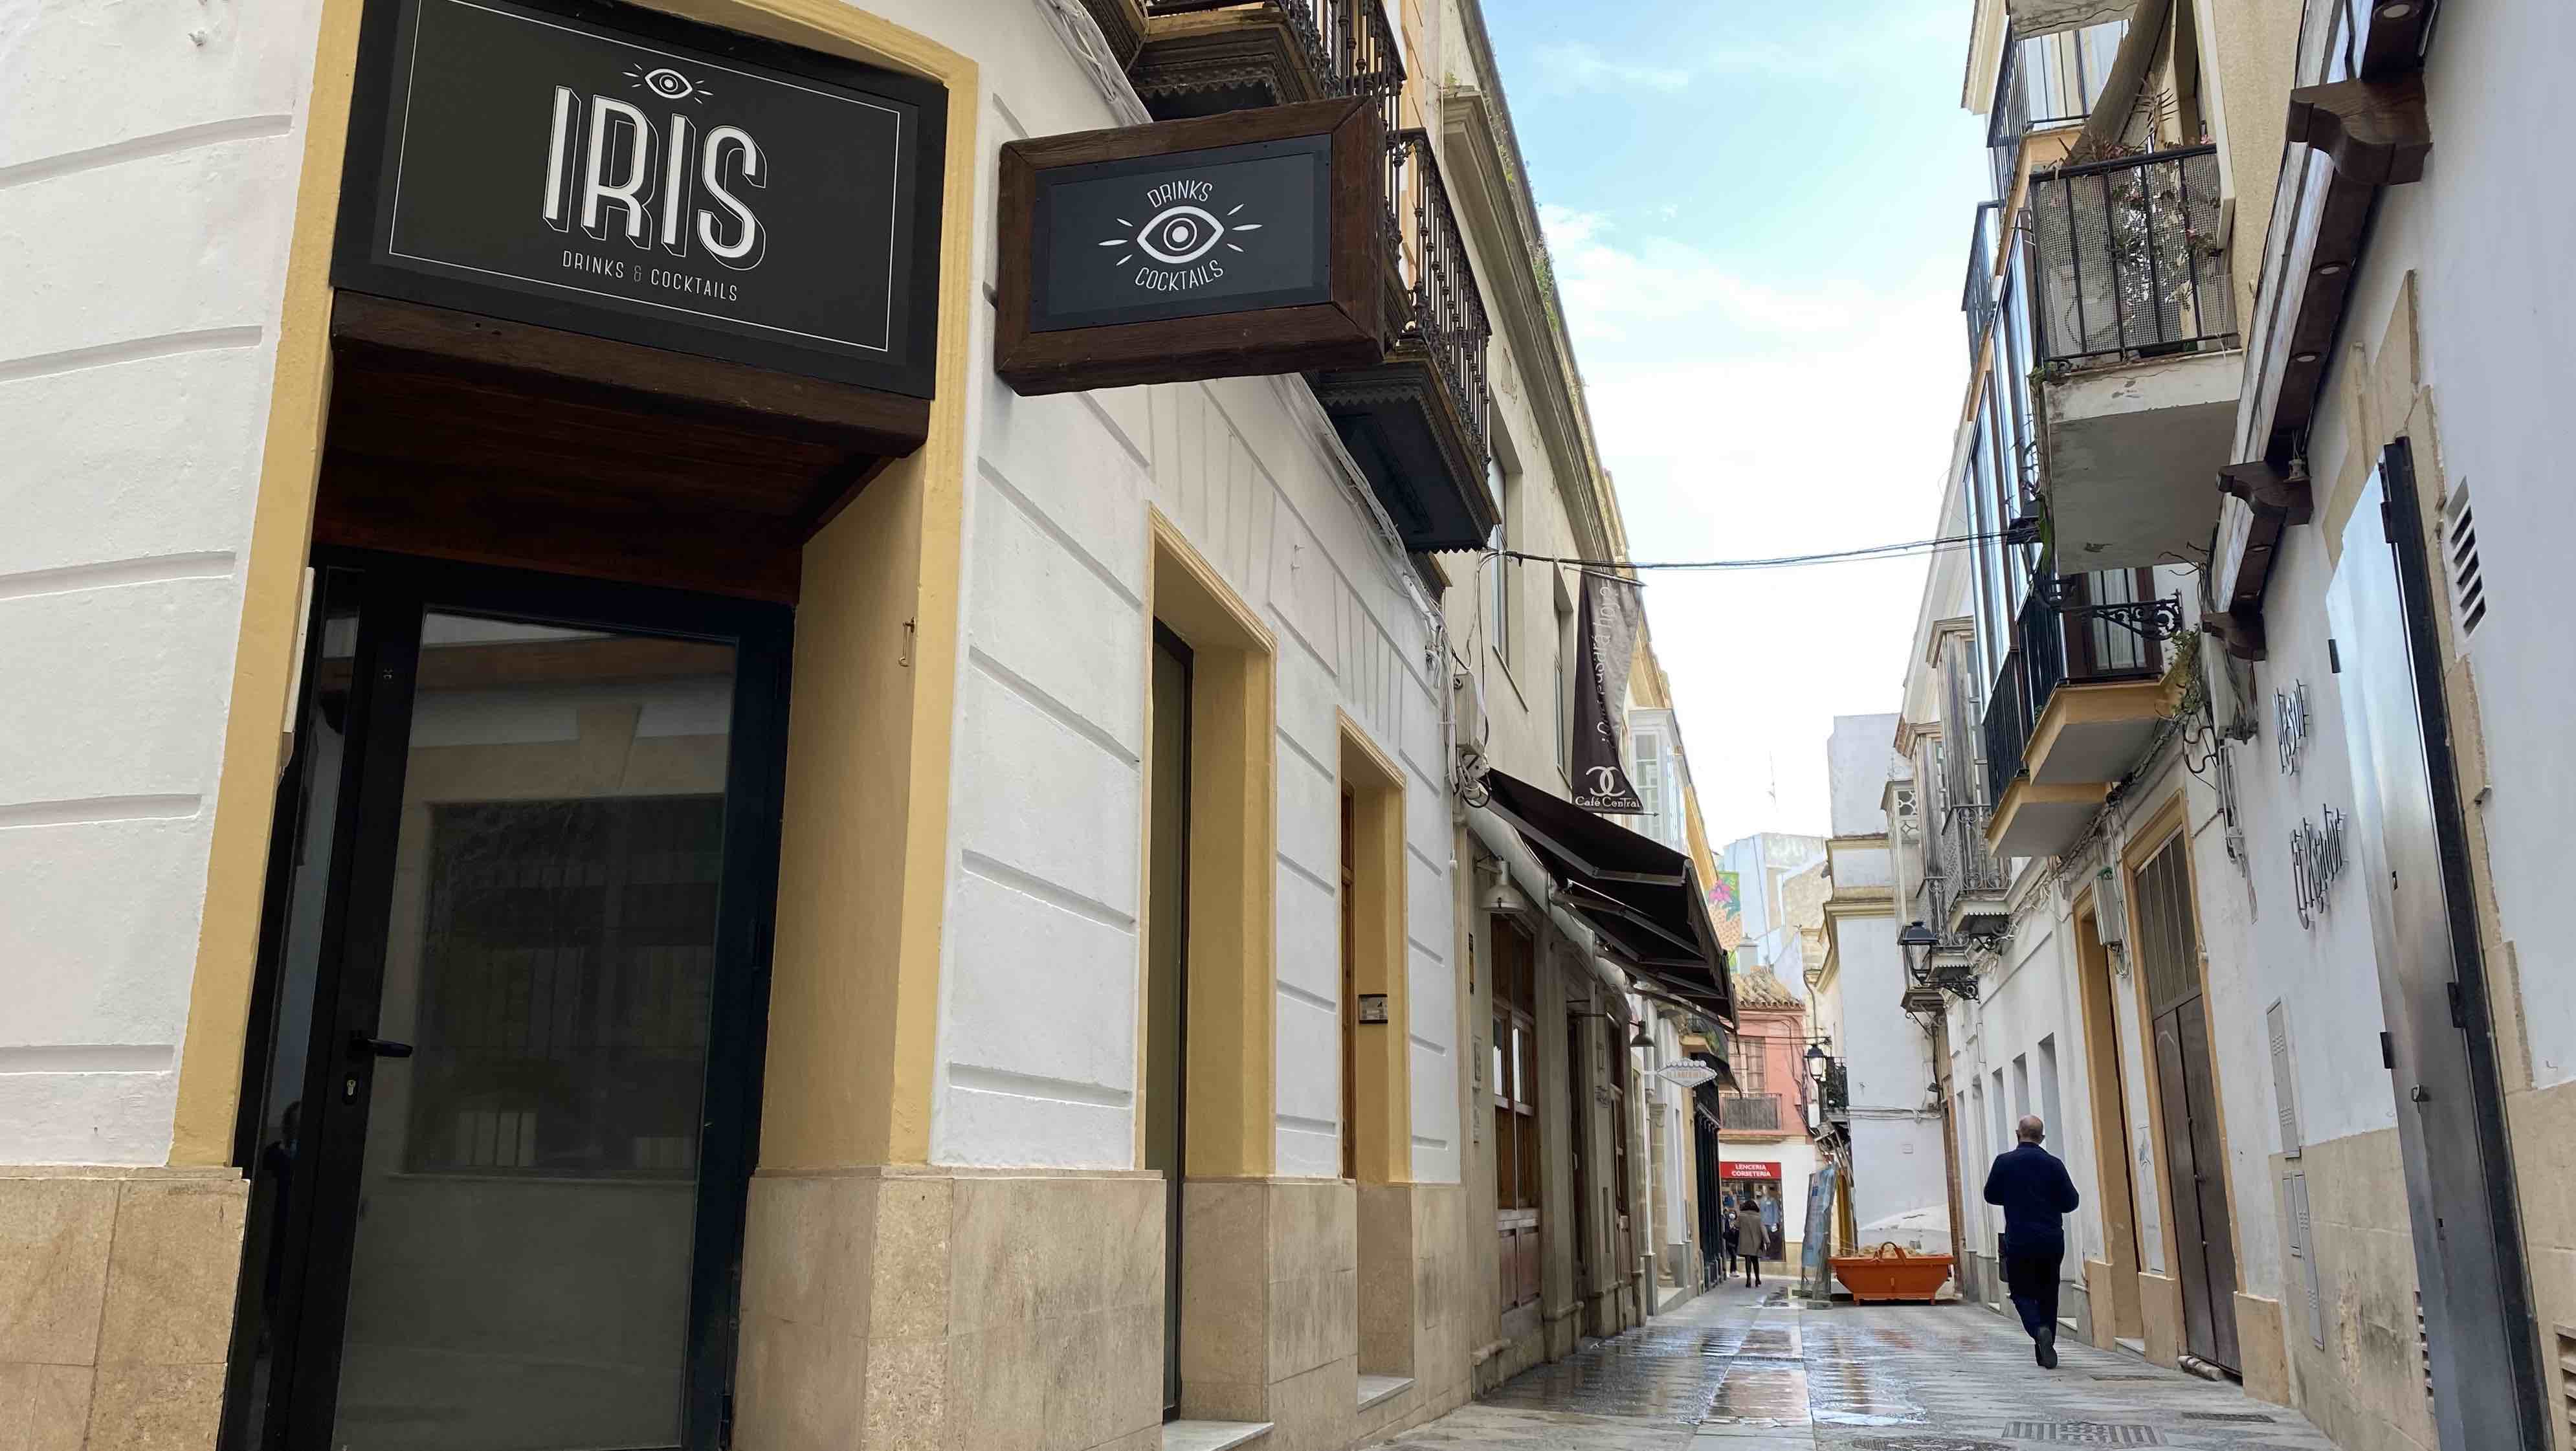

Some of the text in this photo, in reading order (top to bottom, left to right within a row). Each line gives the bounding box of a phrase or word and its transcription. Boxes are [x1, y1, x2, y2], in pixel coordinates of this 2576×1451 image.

[542, 86, 767, 271] IRIS
[1147, 180, 1212, 208] DRINKS
[562, 250, 738, 302] DRINKS & COCKTAILS
[1135, 260, 1223, 291] COCKTAILS
[1575, 795, 1601, 806] Café
